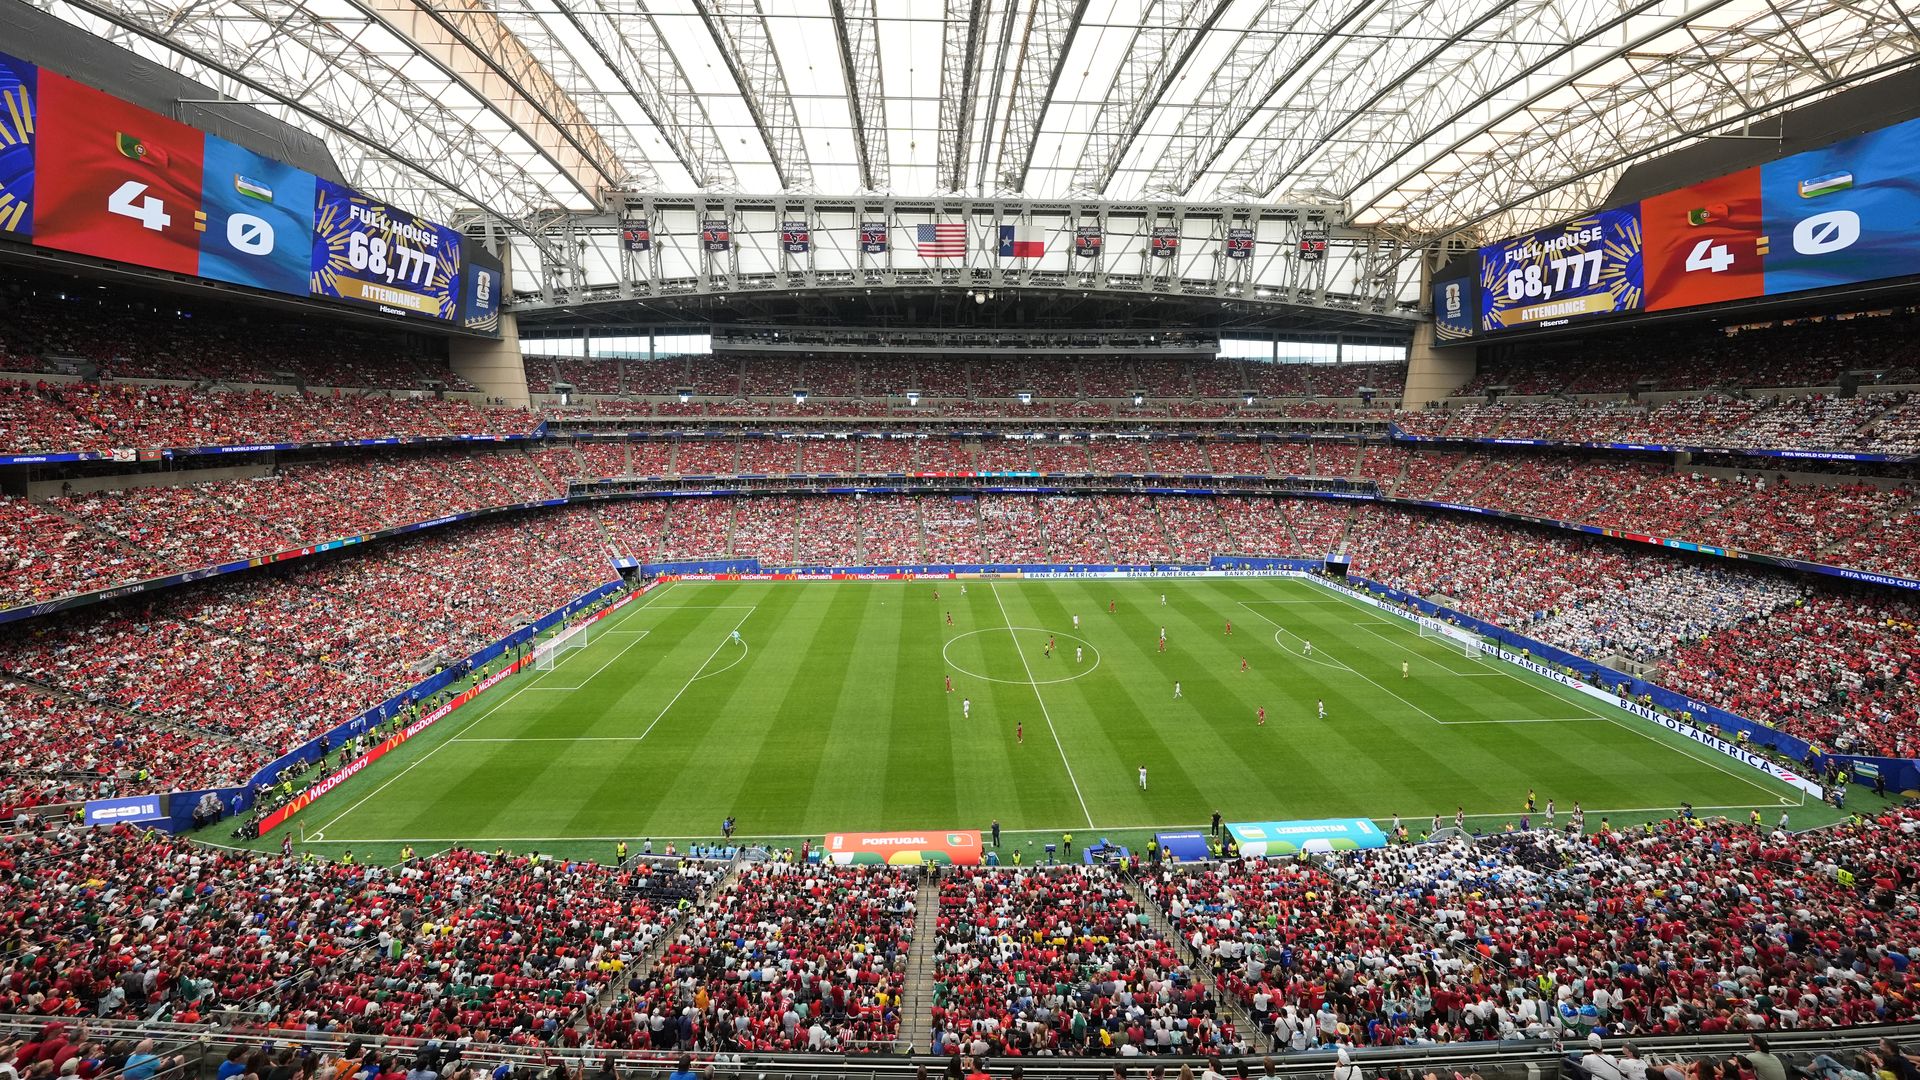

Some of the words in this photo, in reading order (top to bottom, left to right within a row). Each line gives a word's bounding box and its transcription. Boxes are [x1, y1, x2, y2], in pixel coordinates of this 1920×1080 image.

[108, 181, 170, 232] 4
[350, 205, 389, 231] FULL
[392, 220, 439, 248] HOUSE
[1505, 243, 1542, 264] FULL
[1545, 226, 1602, 253] HOUSE
[1686, 239, 1734, 273] 4
[350, 231, 437, 287] 68,777
[1507, 250, 1603, 301] 68,777
[361, 284, 421, 309] ATTENDANCE
[380, 305, 406, 317] Hisense
[1521, 301, 1586, 321] ATTENDANCE
[1540, 318, 1569, 328] Hisense
[1307, 574, 1321, 584] BANK
[1329, 583, 1353, 596] AMERICA
[1840, 571, 1860, 579] FIFA
[1860, 574, 1895, 584] WORLD
[99, 585, 144, 599] HOUTON
[1377, 602, 1396, 613] BANK
[1398, 609, 1406, 617] OF
[1408, 613, 1443, 632] AMERICA
[478, 667, 512, 693] McDelivery
[1687, 701, 1708, 714] FIFA
[406, 704, 452, 738] McDonald's
[1620, 700, 1660, 724] BANK
[1665, 719, 1685, 732] OF
[1690, 730, 1772, 773] AMERICA
[310, 756, 369, 801] McDelivery
[862, 837, 928, 845] PORTUGAL
[1275, 824, 1348, 834] UZBEKISTAN
